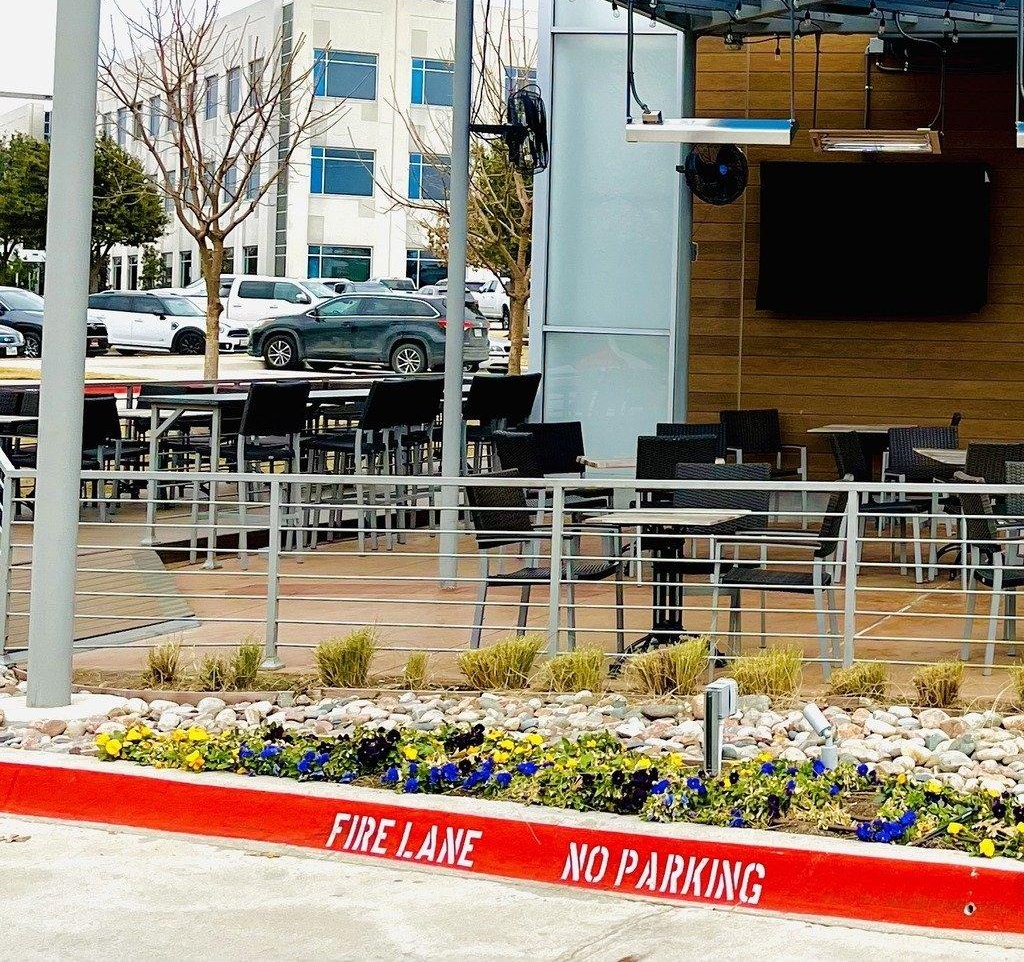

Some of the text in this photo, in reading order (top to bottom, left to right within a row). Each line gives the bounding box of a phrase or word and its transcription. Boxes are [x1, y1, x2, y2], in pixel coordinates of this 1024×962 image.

[325, 812, 483, 868] FIRE LANE
[560, 842, 766, 905] NO PARKING
